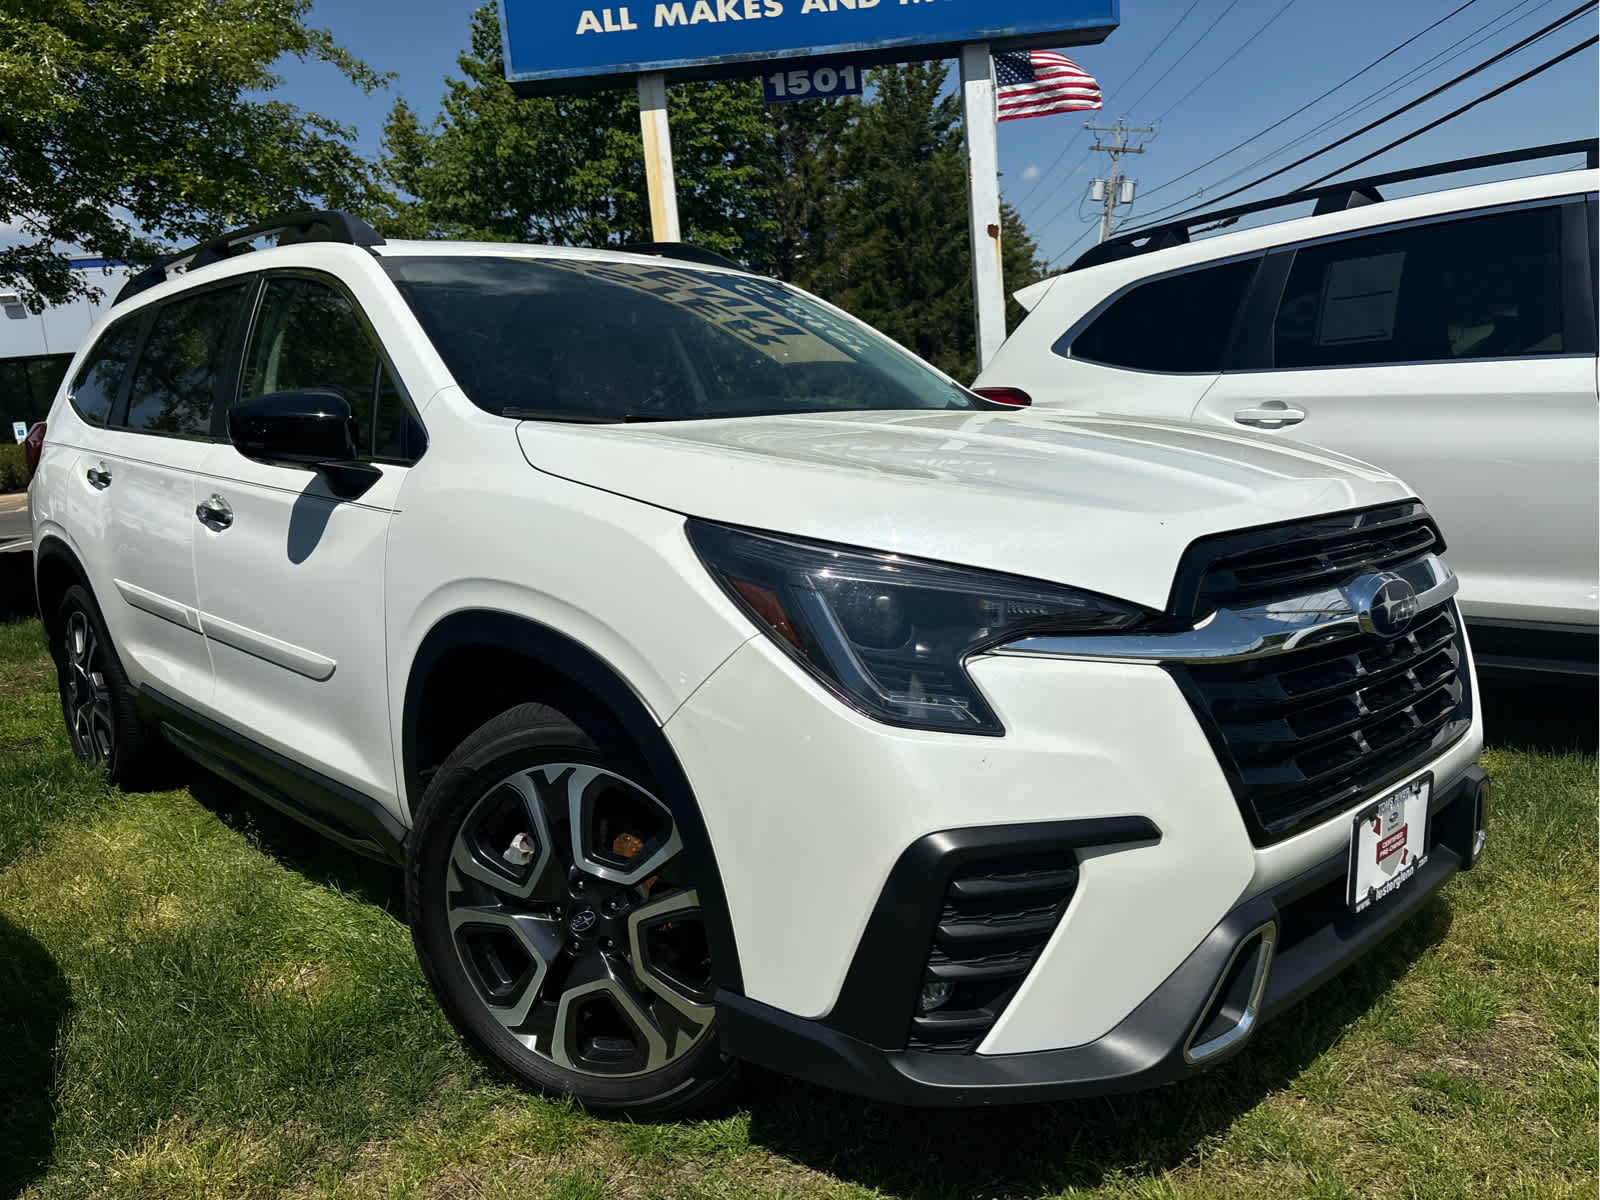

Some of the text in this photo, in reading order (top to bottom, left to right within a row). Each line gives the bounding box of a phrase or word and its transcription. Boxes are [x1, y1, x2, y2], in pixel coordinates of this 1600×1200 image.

[576, 7, 638, 35] ALL
[654, 0, 784, 28] MAKES
[768, 65, 856, 97] 1501
